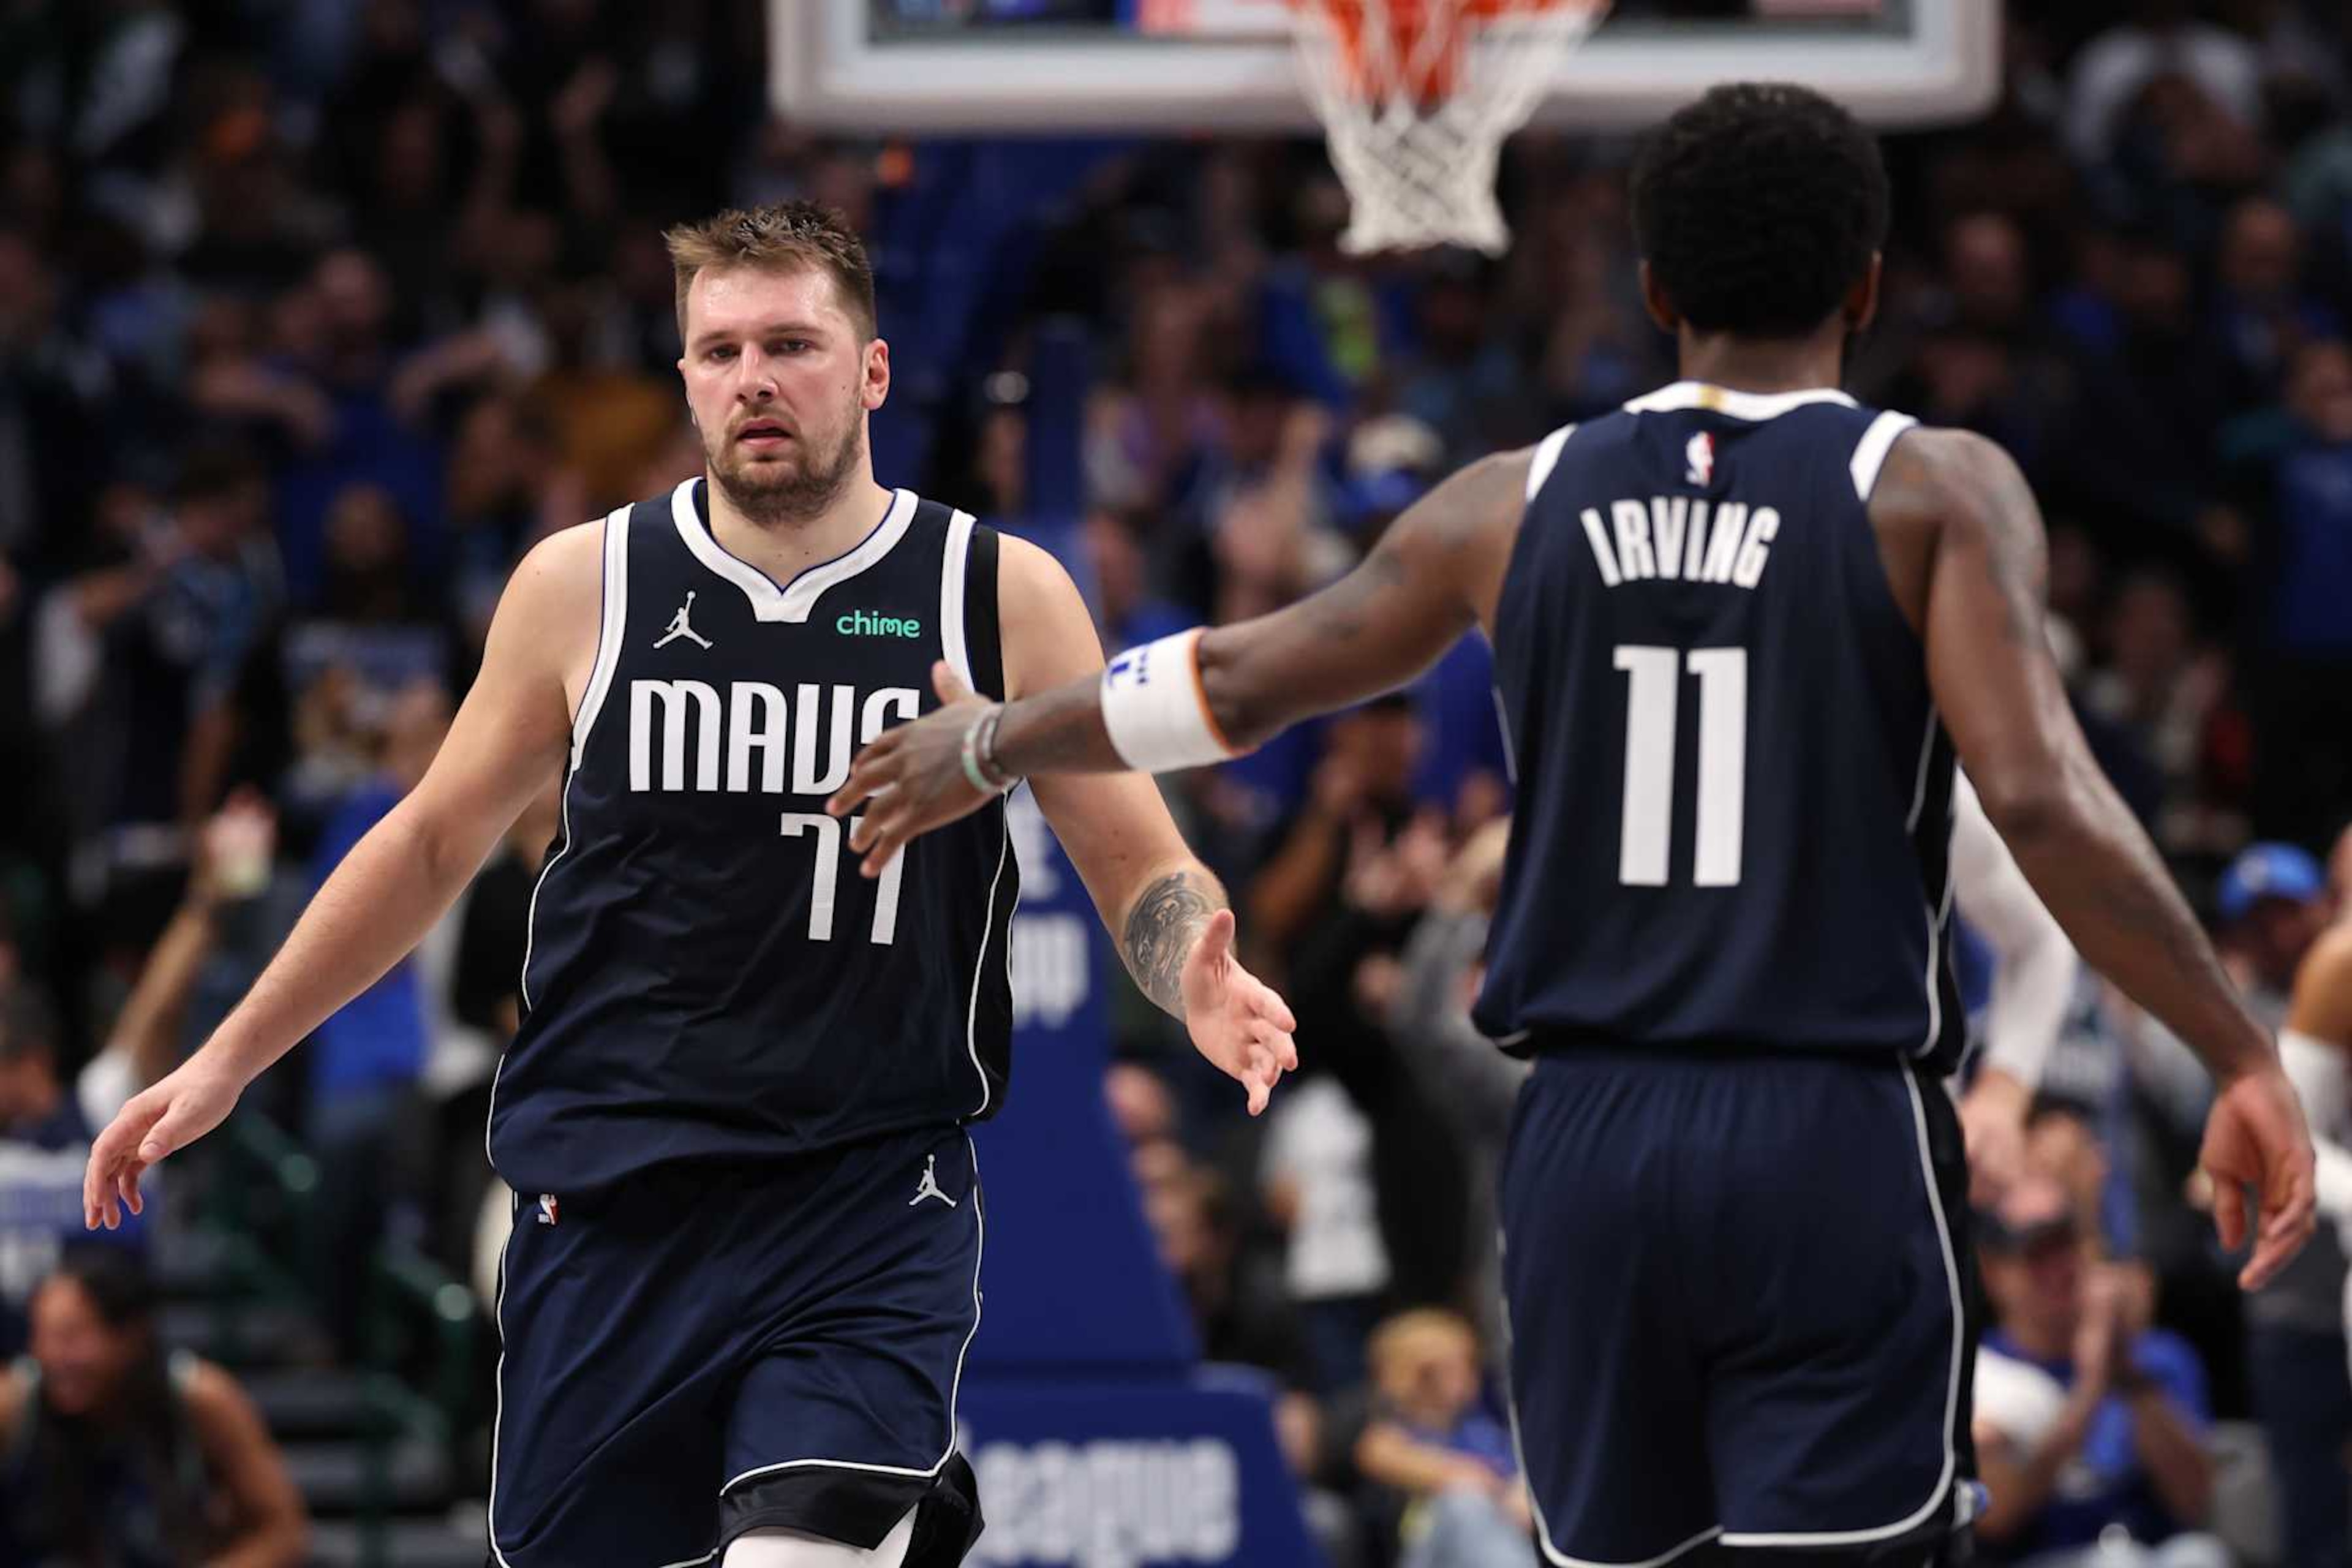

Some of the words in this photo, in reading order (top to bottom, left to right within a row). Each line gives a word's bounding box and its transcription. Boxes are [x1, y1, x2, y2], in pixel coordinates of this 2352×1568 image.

[1580, 497, 1781, 589] IRVING
[835, 609, 921, 639] chime
[1612, 645, 1747, 888] 11
[957, 1415, 1241, 1568] eague
